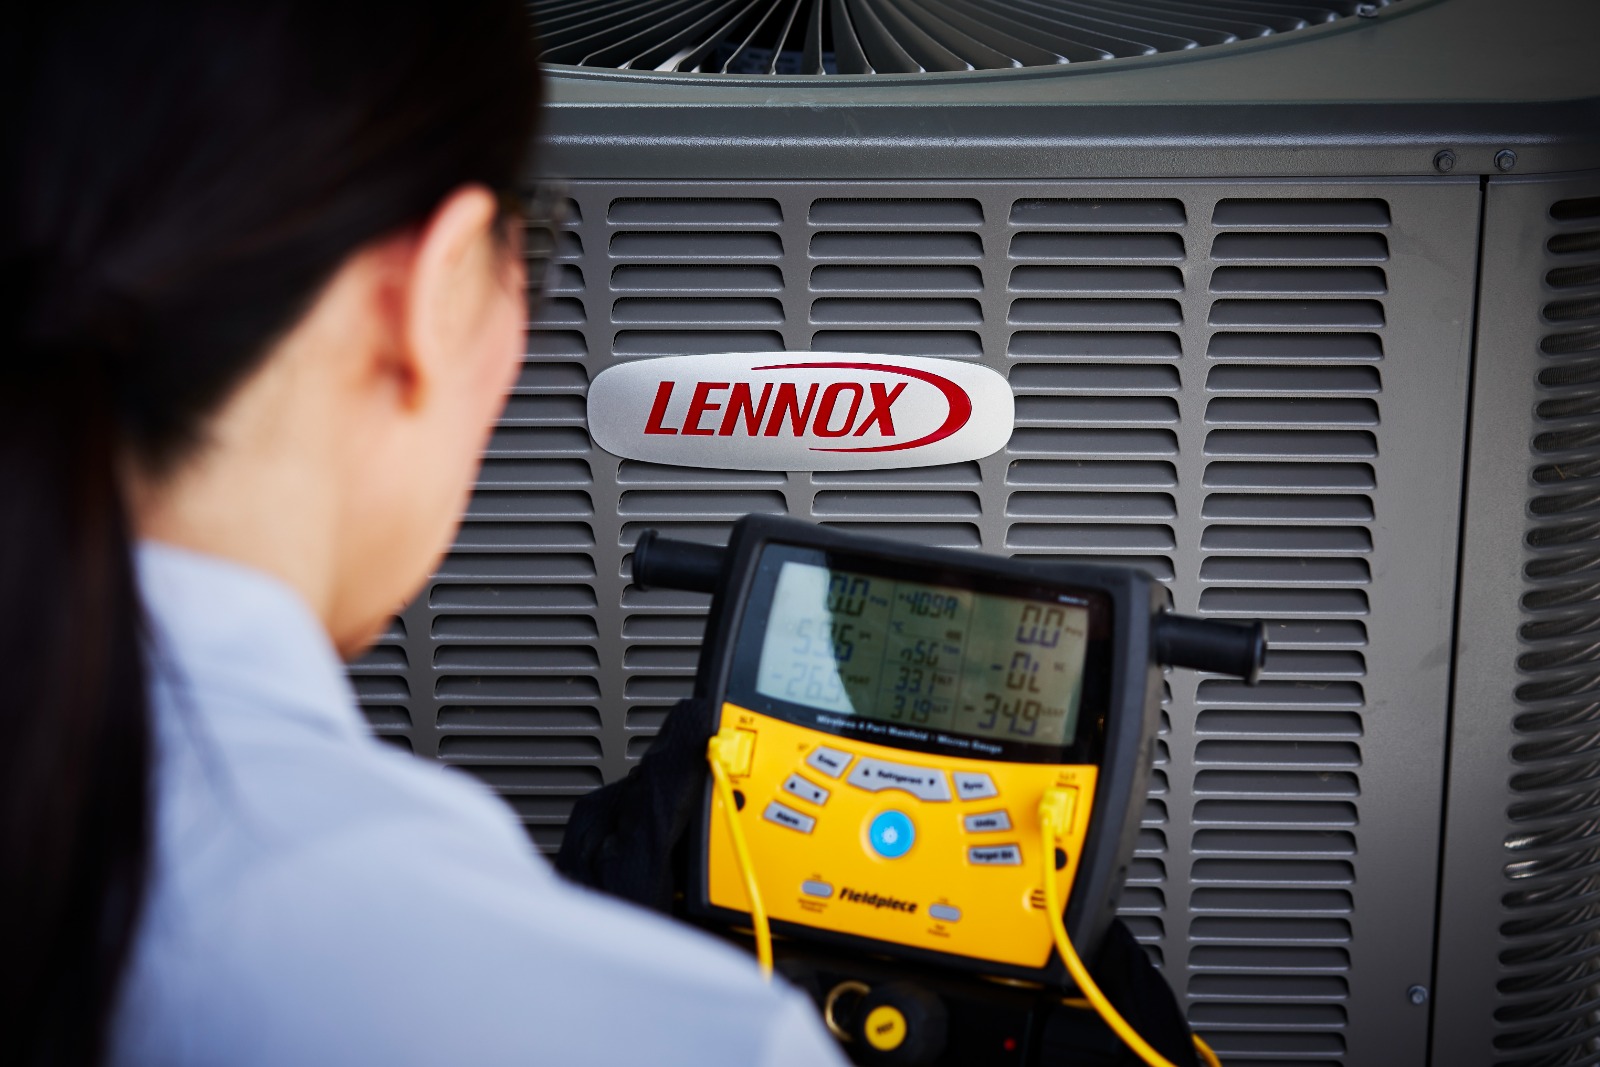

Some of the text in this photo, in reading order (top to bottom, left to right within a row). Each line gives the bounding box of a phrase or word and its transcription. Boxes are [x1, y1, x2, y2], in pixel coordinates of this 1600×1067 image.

[643, 380, 909, 438] LENNOX
[816, 714, 856, 729] Wireless
[866, 723, 887, 735] Port
[888, 726, 928, 741] Manifold
[937, 735, 970, 748] Micron
[971, 740, 1003, 754] Gauge
[839, 887, 918, 914] Fieldpiece
